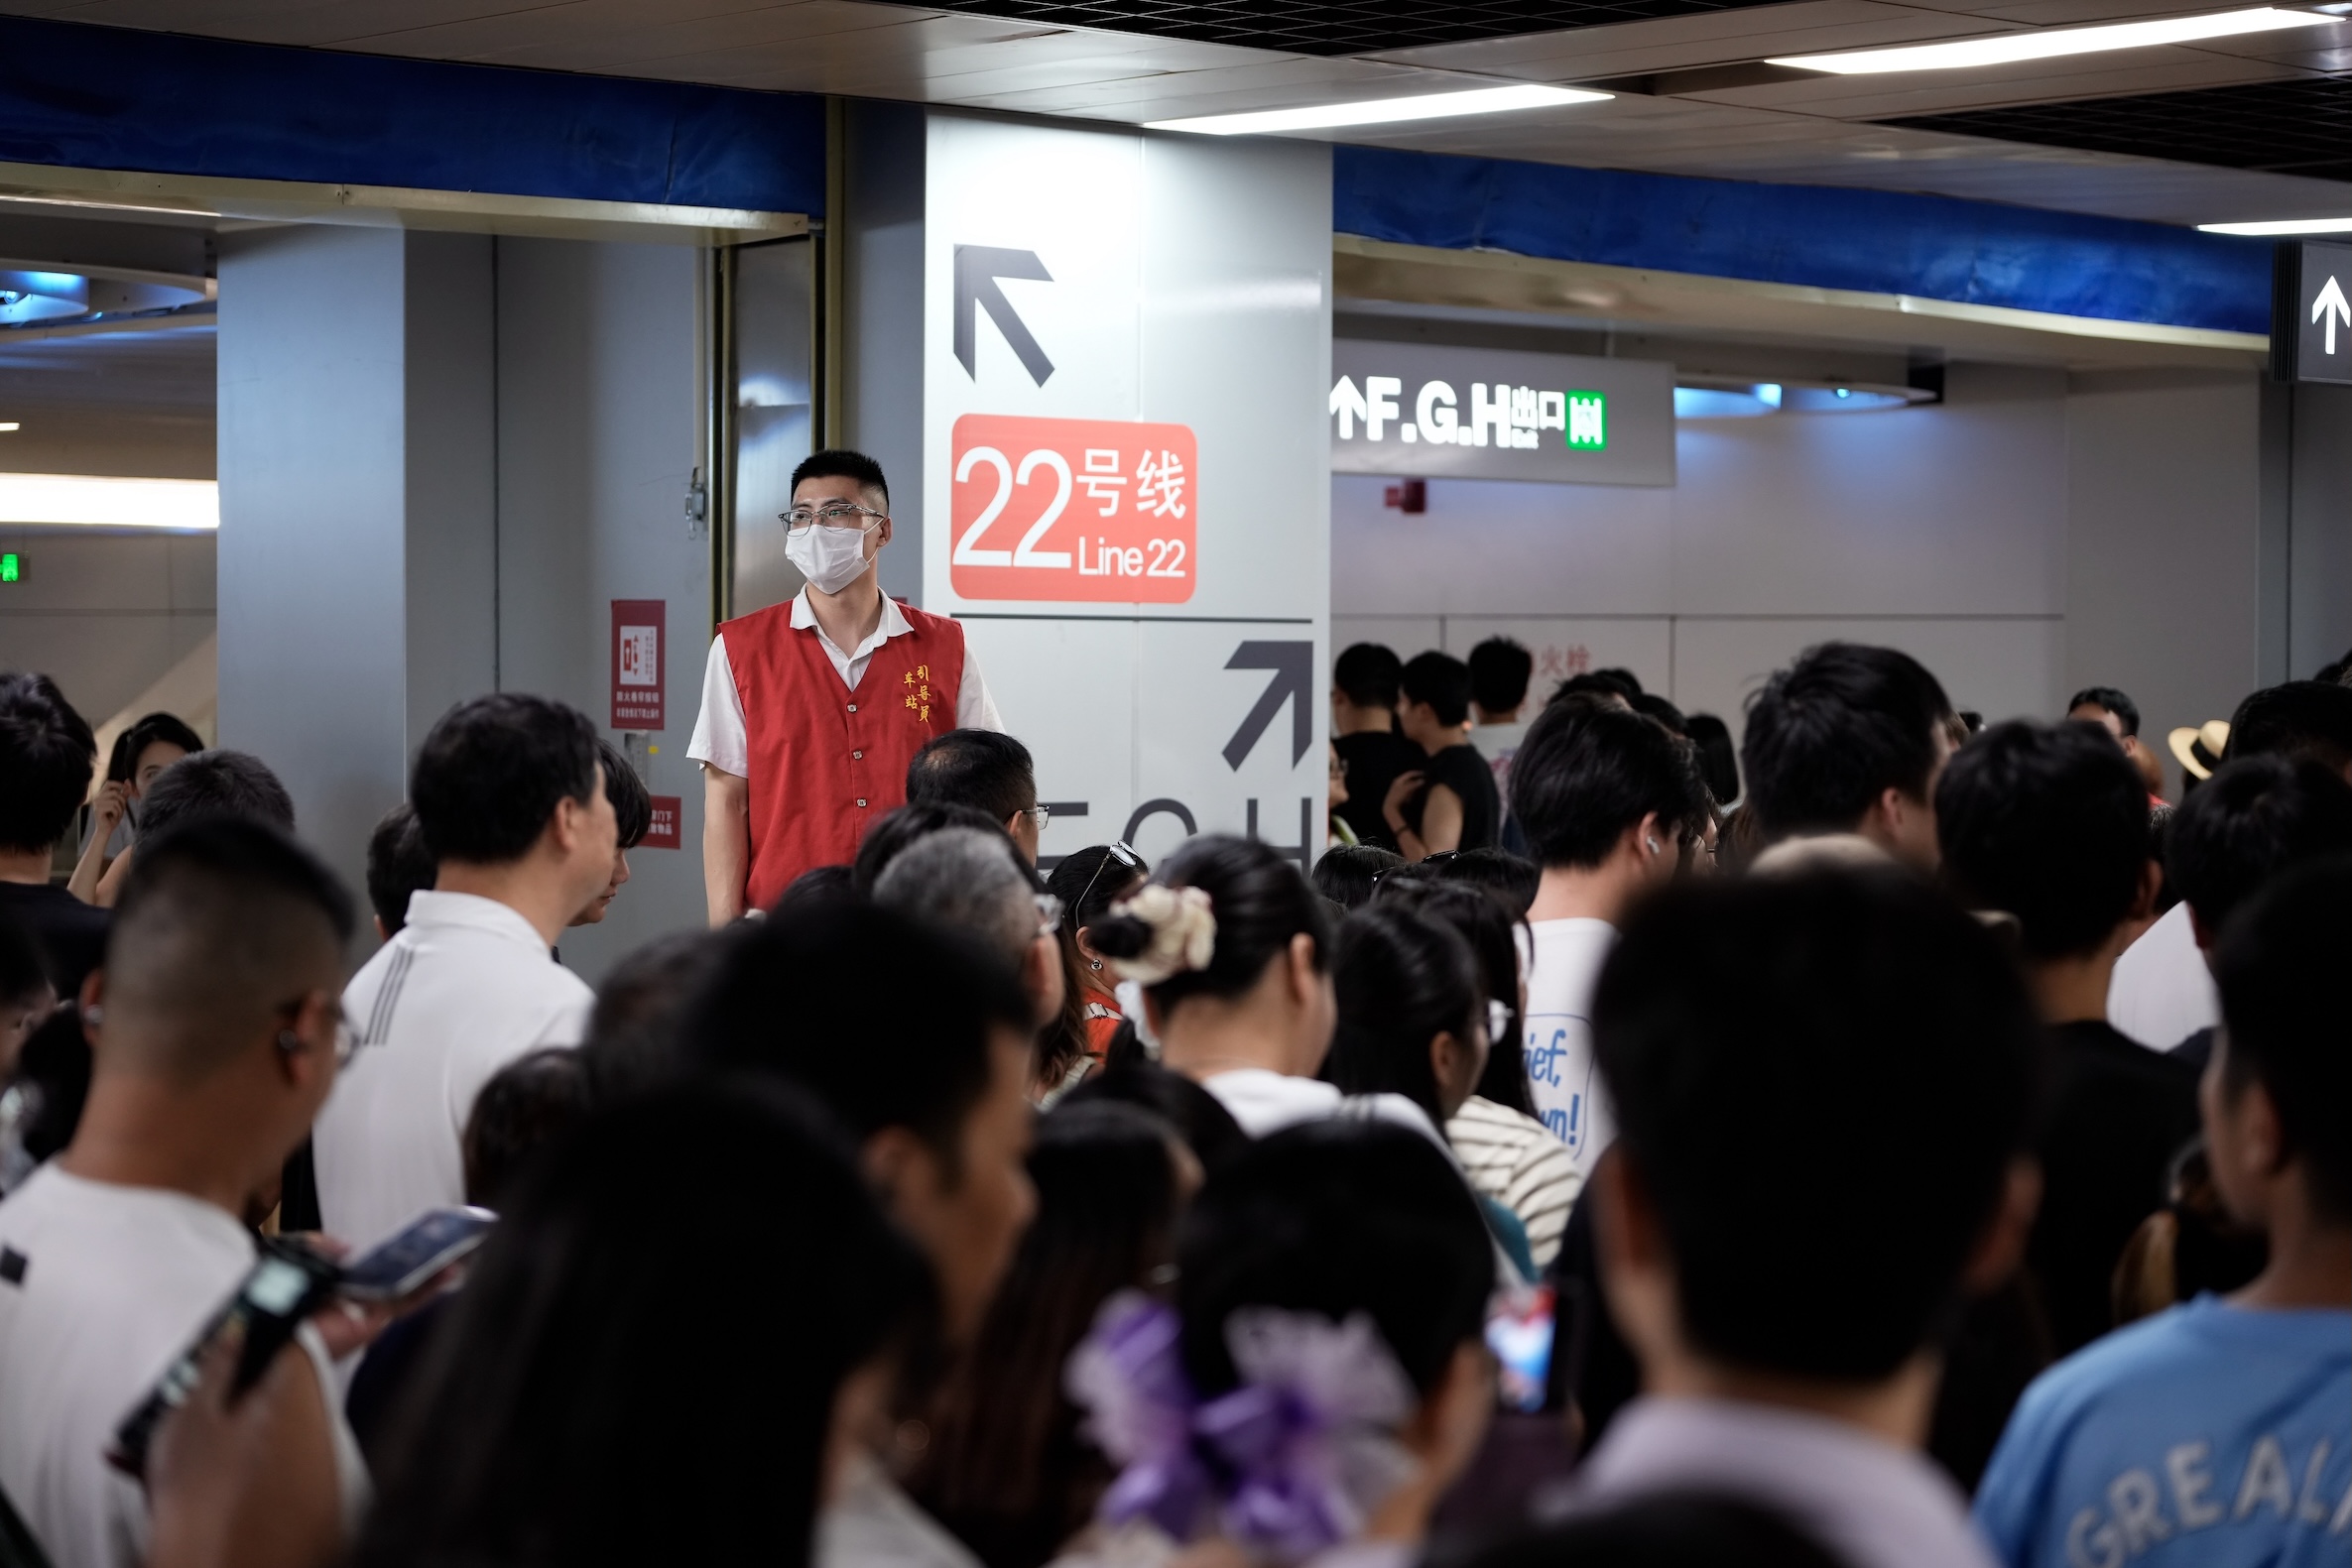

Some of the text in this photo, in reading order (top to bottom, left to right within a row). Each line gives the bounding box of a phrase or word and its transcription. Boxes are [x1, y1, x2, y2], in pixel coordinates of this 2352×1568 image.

[1511, 385, 1566, 431] 出口
[1078, 536, 1186, 578] Line 22
[903, 671, 919, 710] 车站
[917, 664, 931, 723] 引导员
